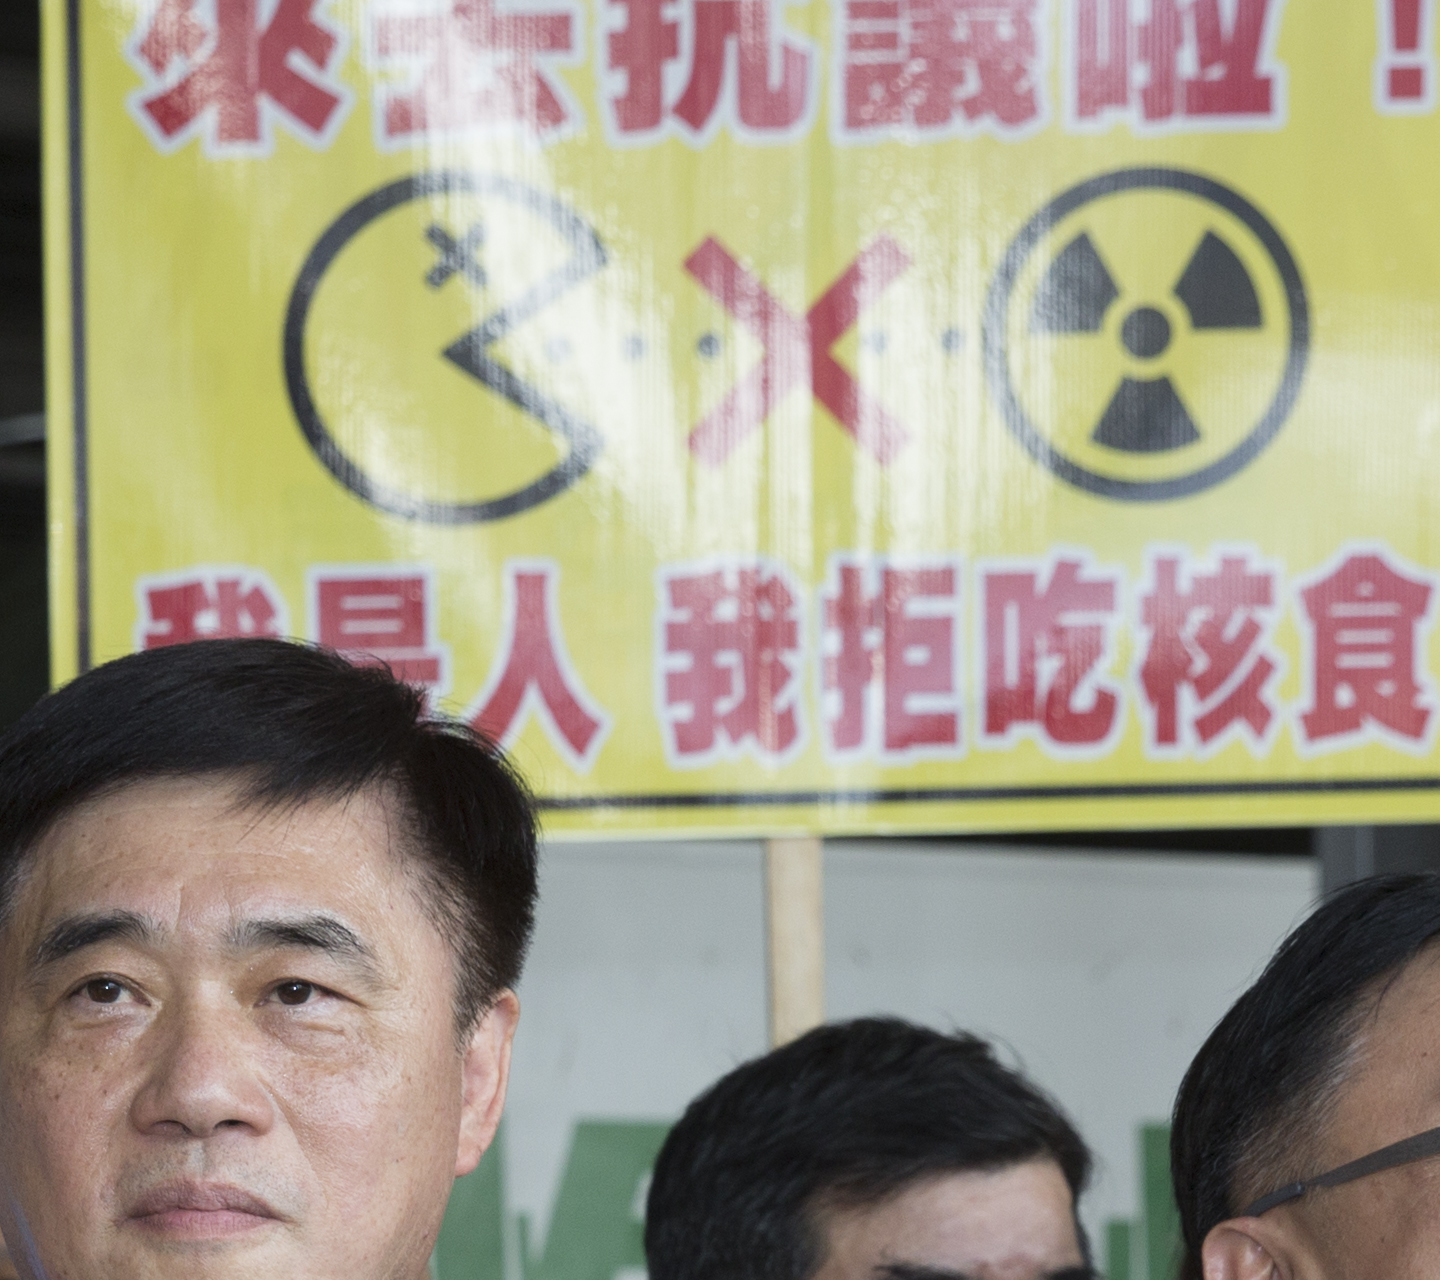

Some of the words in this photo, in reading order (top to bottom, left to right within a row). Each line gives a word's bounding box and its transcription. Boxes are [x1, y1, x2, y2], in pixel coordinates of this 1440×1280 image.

[661, 550, 1440, 759] 我拒吃核食
